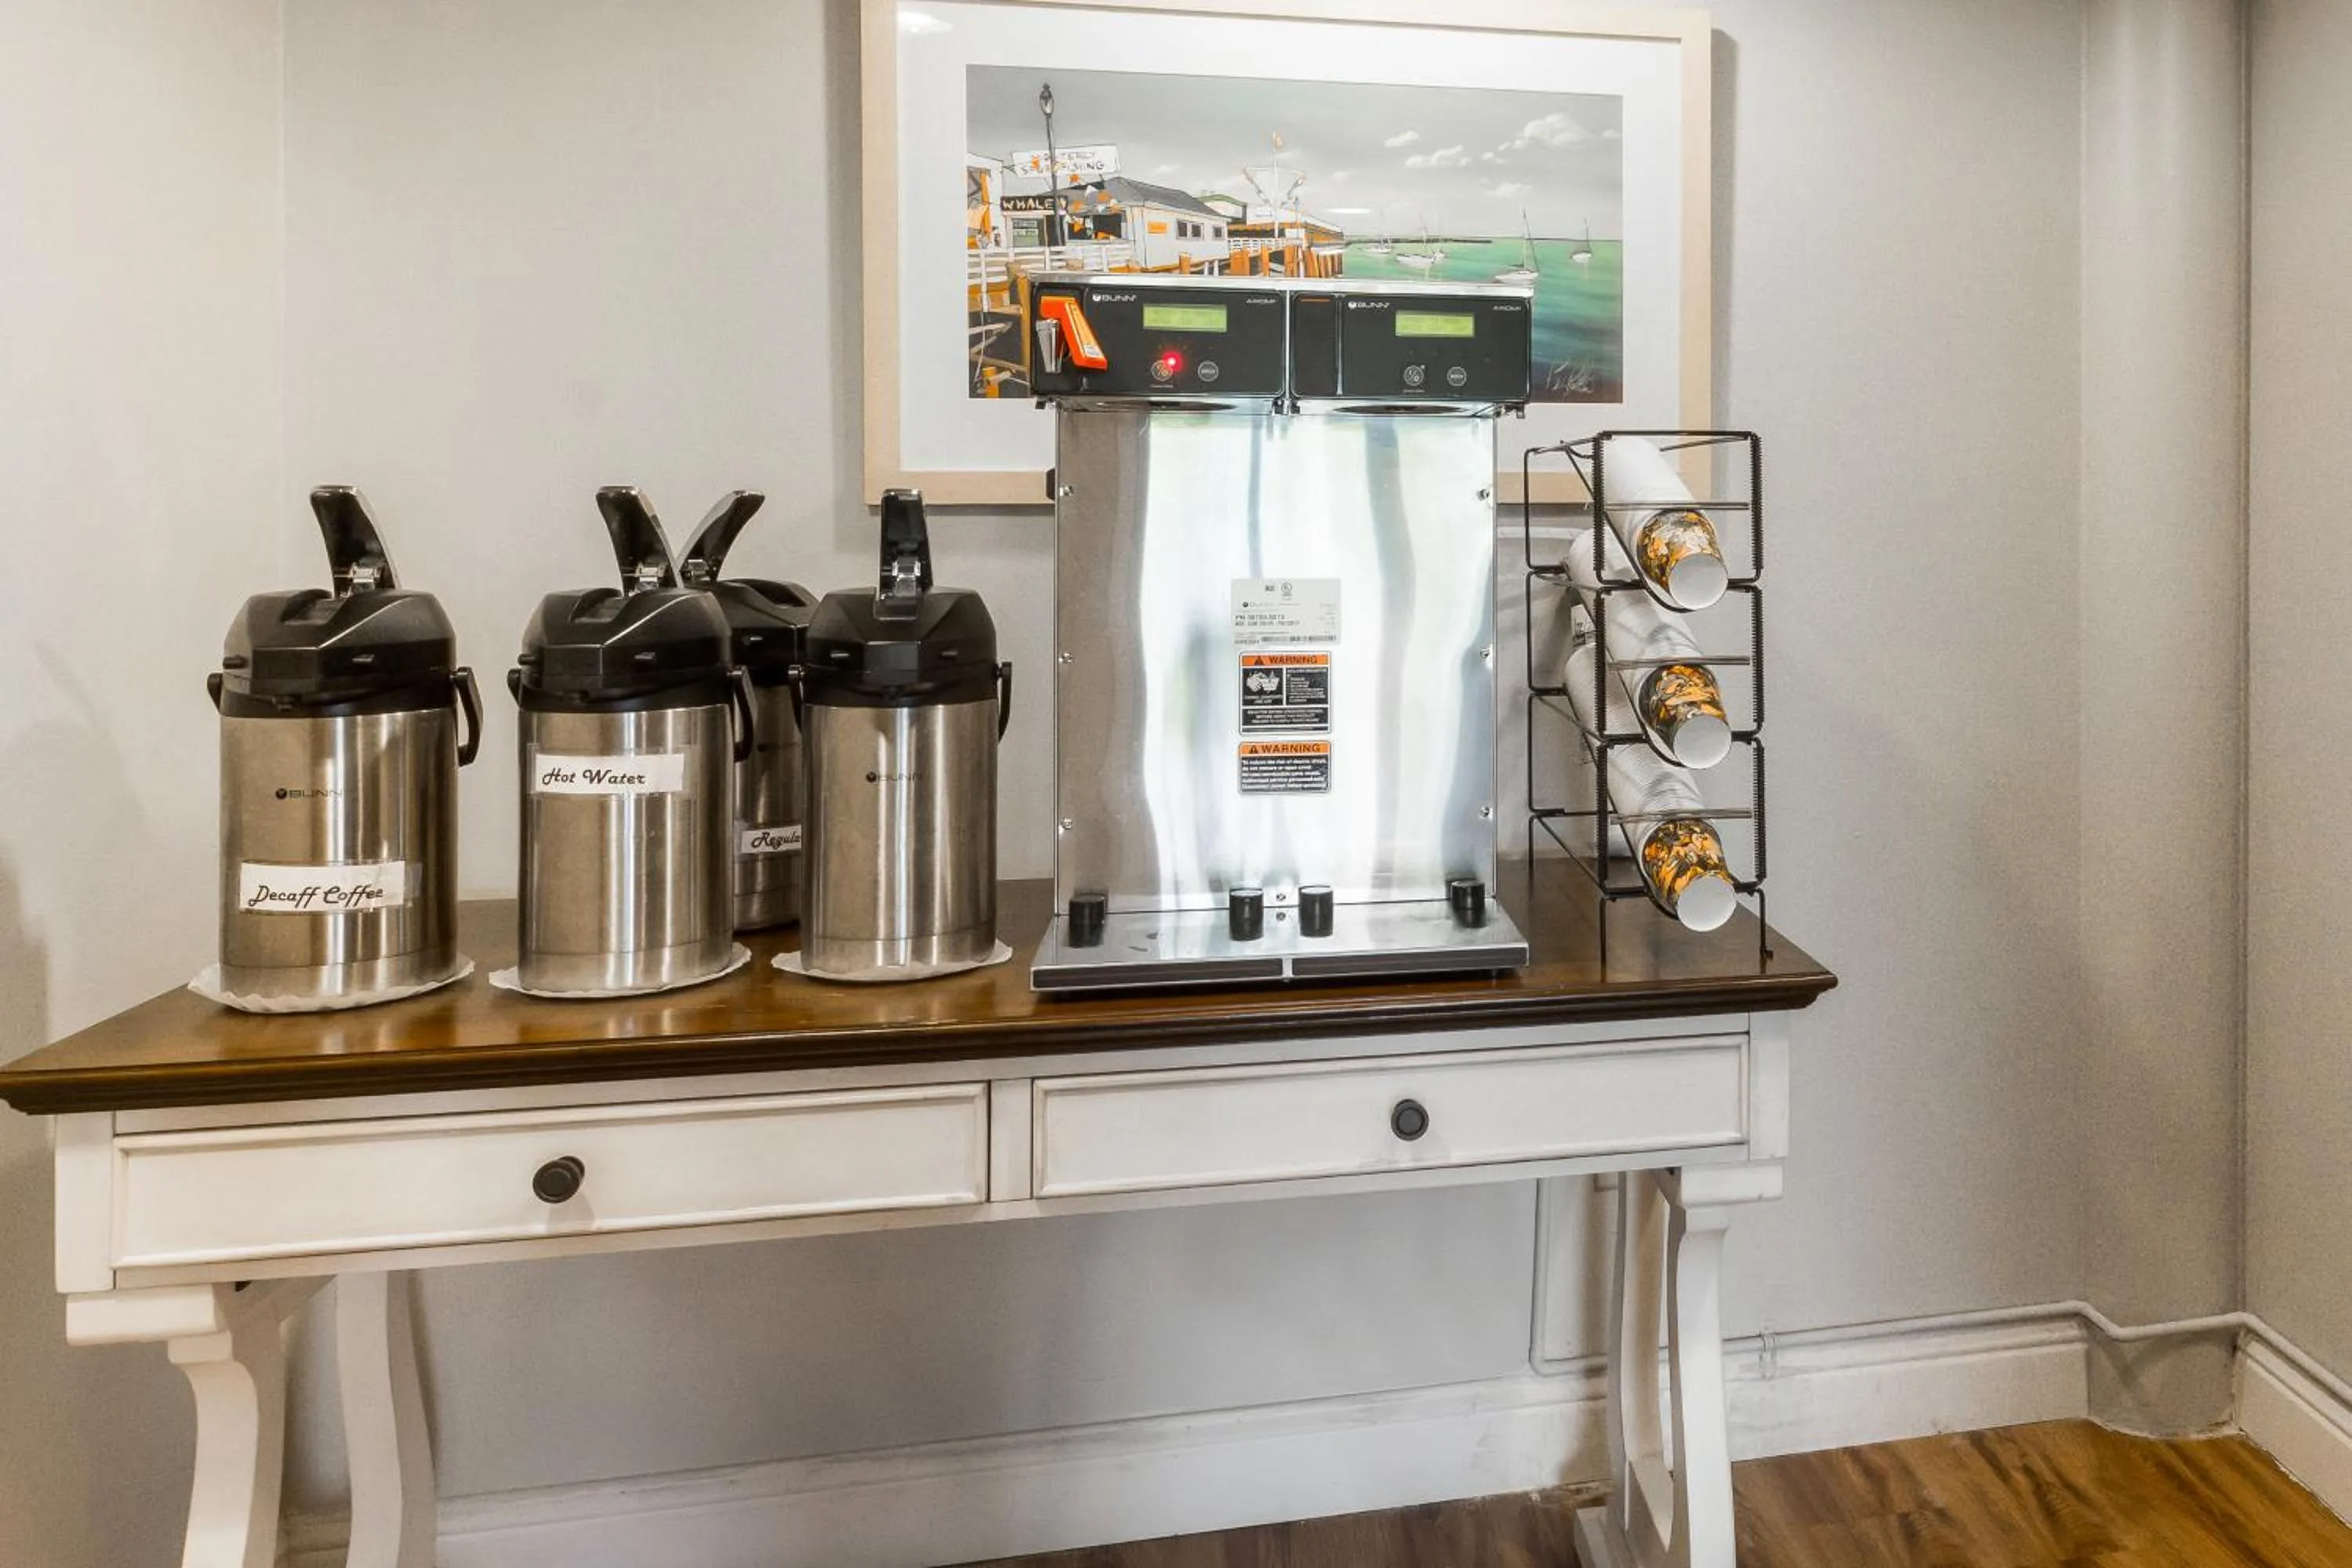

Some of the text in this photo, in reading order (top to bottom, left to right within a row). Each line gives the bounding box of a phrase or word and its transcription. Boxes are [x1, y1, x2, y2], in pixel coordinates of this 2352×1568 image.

[1003, 197, 1054, 211] WHALE
[1270, 655, 1318, 665] WARNING
[1261, 743, 1321, 753] WARNING
[542, 768, 646, 786] Hot Water
[289, 789, 343, 798] BUNN
[248, 884, 384, 909] Decaff Coffee
